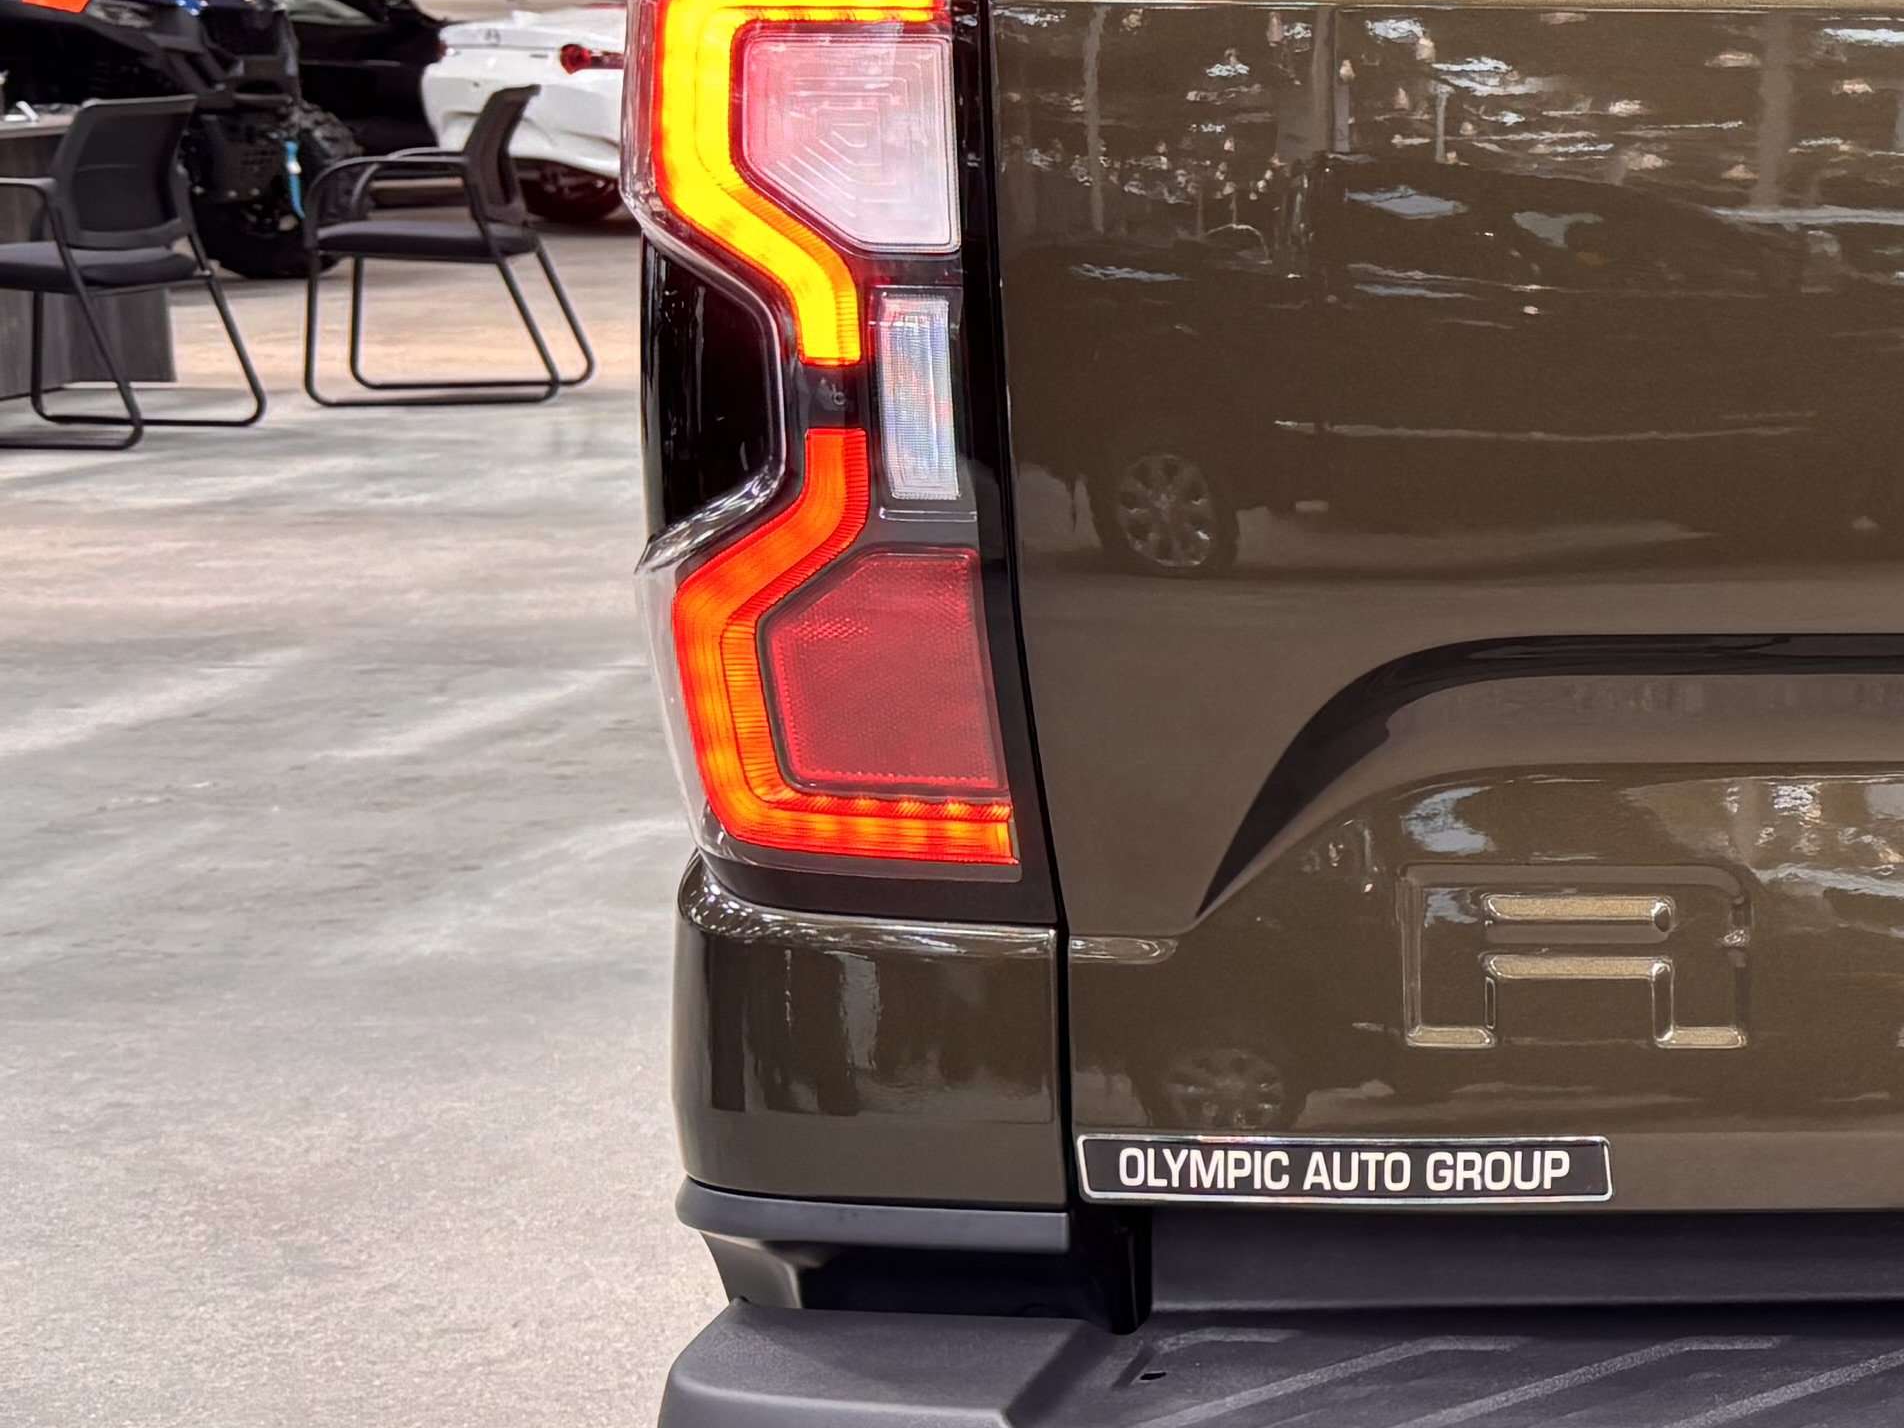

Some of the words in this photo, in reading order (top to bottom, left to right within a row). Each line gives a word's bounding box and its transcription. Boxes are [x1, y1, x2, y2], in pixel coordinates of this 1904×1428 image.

[1118, 1146, 1291, 1191] OLYMPIC
[1302, 1150, 1412, 1192] AUTO
[1425, 1150, 1571, 1193] GROUP
